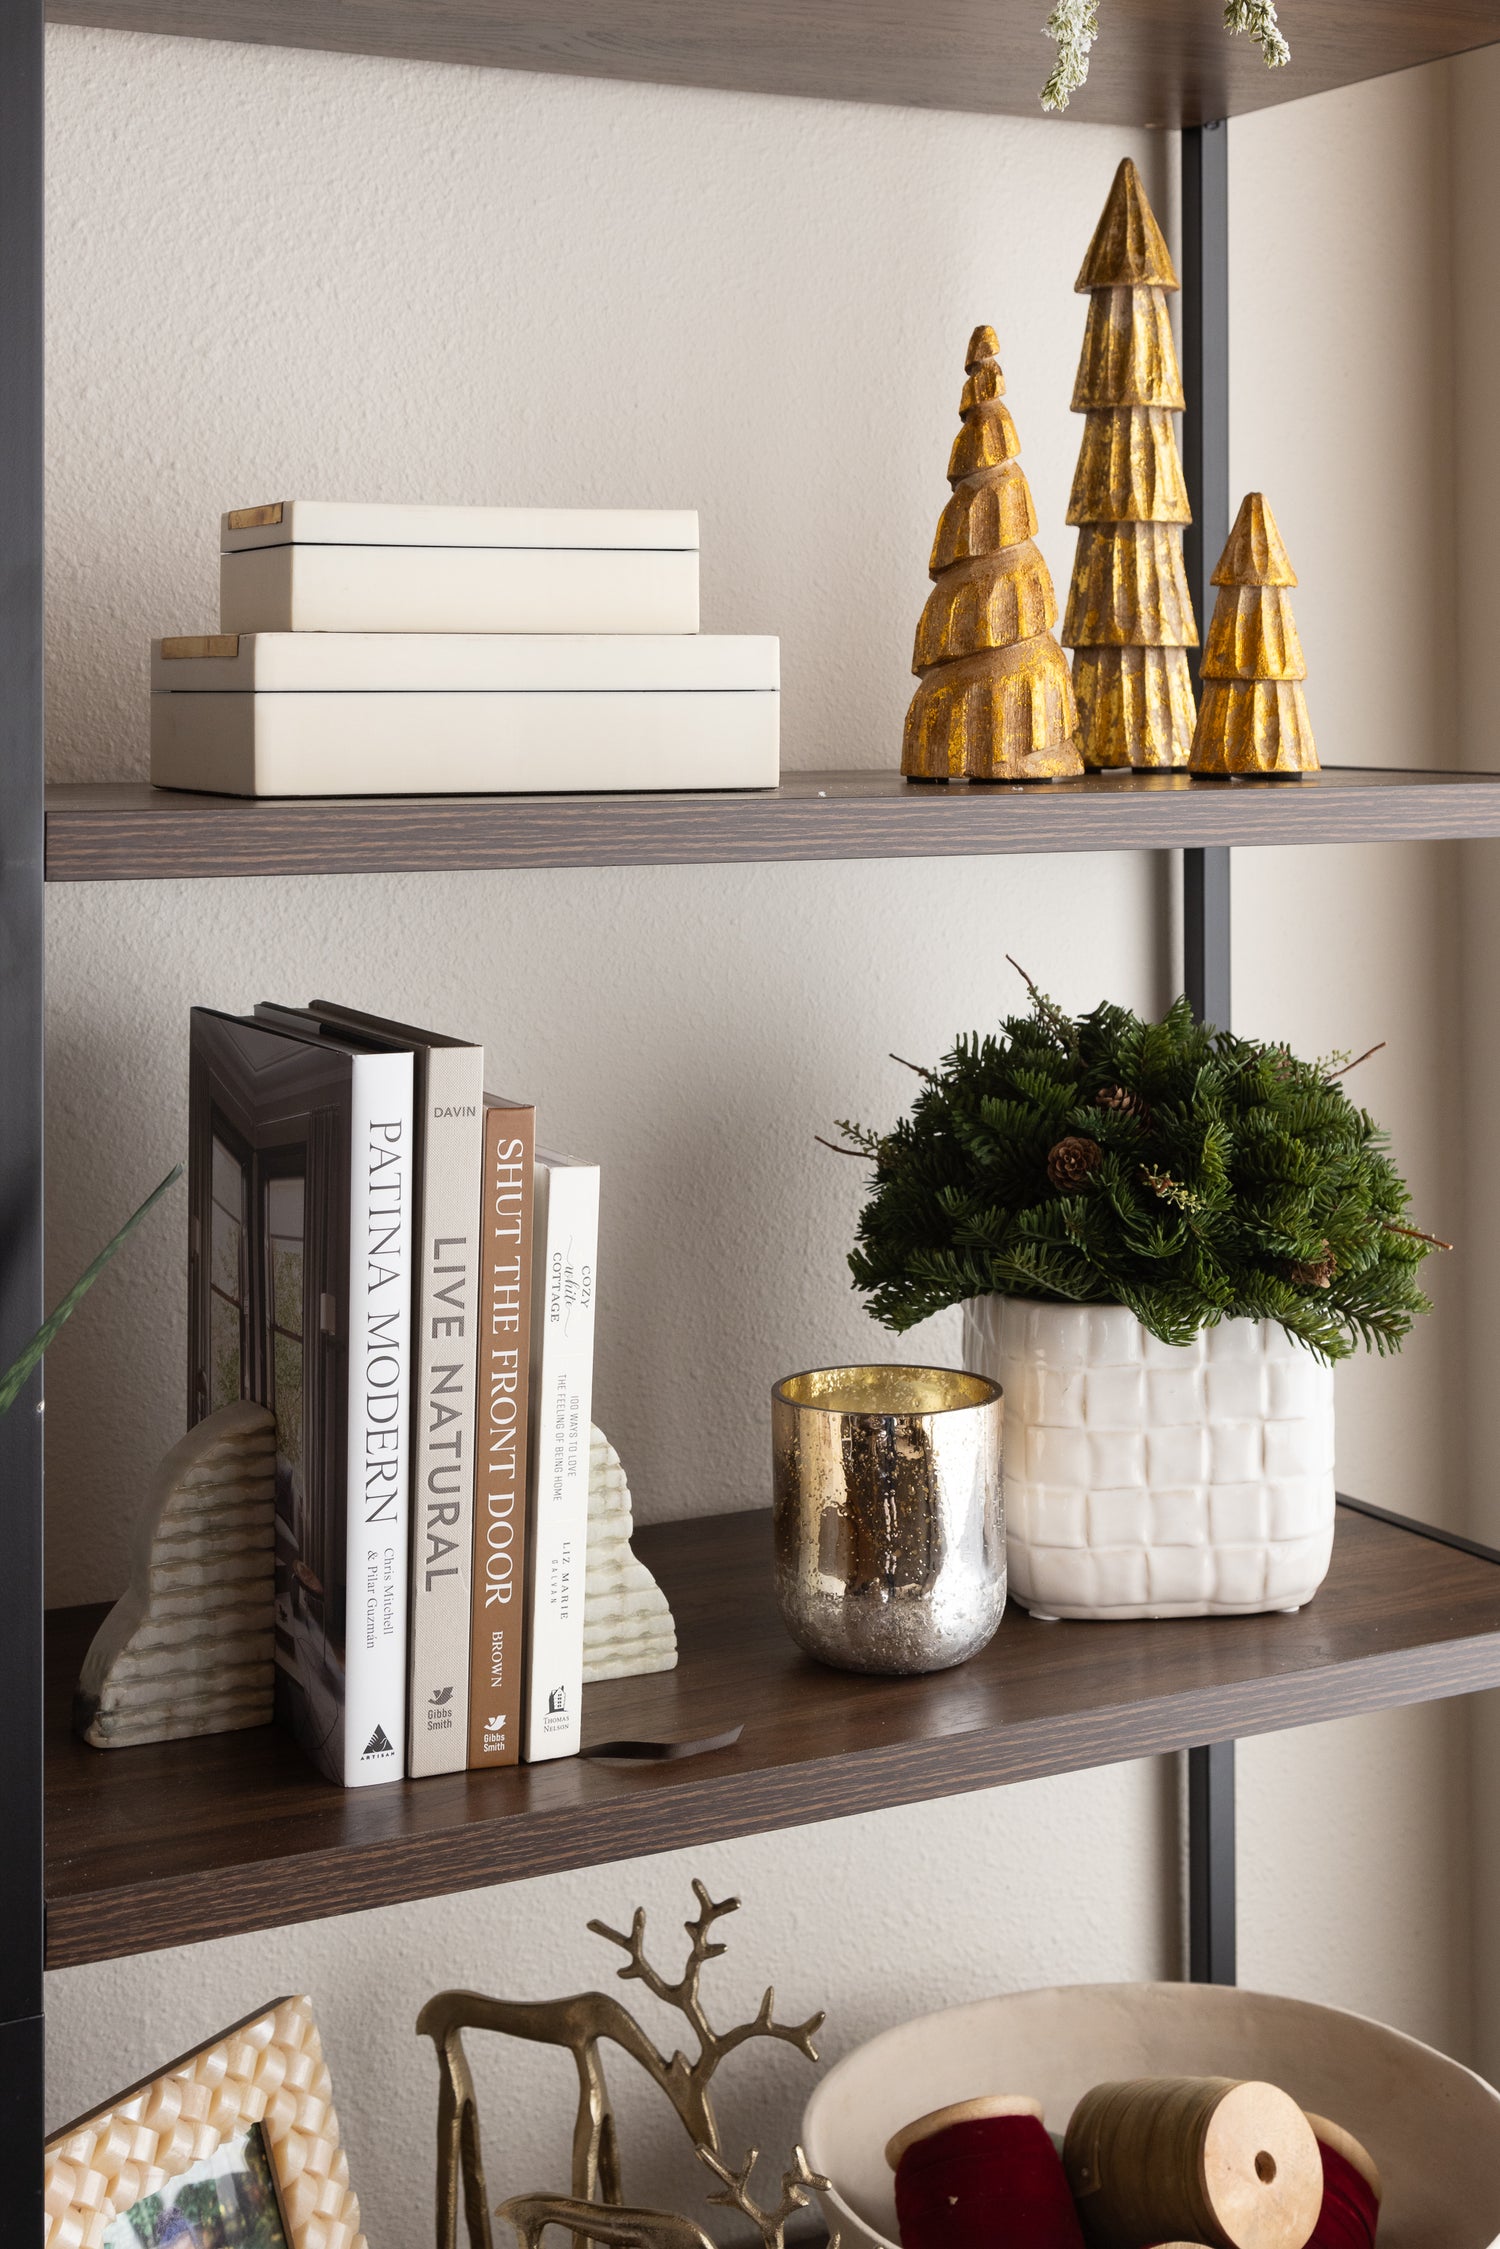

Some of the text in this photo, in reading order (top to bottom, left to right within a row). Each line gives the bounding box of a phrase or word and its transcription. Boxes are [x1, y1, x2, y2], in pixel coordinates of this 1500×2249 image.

[434, 1106, 476, 1118] DAVIN
[550, 1252, 562, 1323] COTTAGE
[580, 1265, 592, 1309] COZY
[365, 1119, 402, 1525] PATINA MODERN
[484, 1138, 524, 1609] SHUT THE FRONT DOOR
[425, 1237, 467, 1593] LIVE NATURAL
[553, 1374, 566, 1502] THE FEELING OF BEING HOME
[567, 1395, 579, 1477] 100 WAYS TO LOVE
[366, 1550, 378, 1649] & Pilar Guzmán
[383, 1547, 395, 1635] Chris Mitchell
[550, 1559, 558, 1604] GALVAN
[560, 1542, 570, 1620] LIZ MARIE
[490, 1631, 504, 1688] BROWN
[427, 1708, 453, 1720] Gibbs
[427, 1719, 453, 1731] Smith
[483, 1733, 505, 1743] Gibbs
[360, 1751, 395, 1761] ARTISAN
[483, 1742, 505, 1753] Smith
